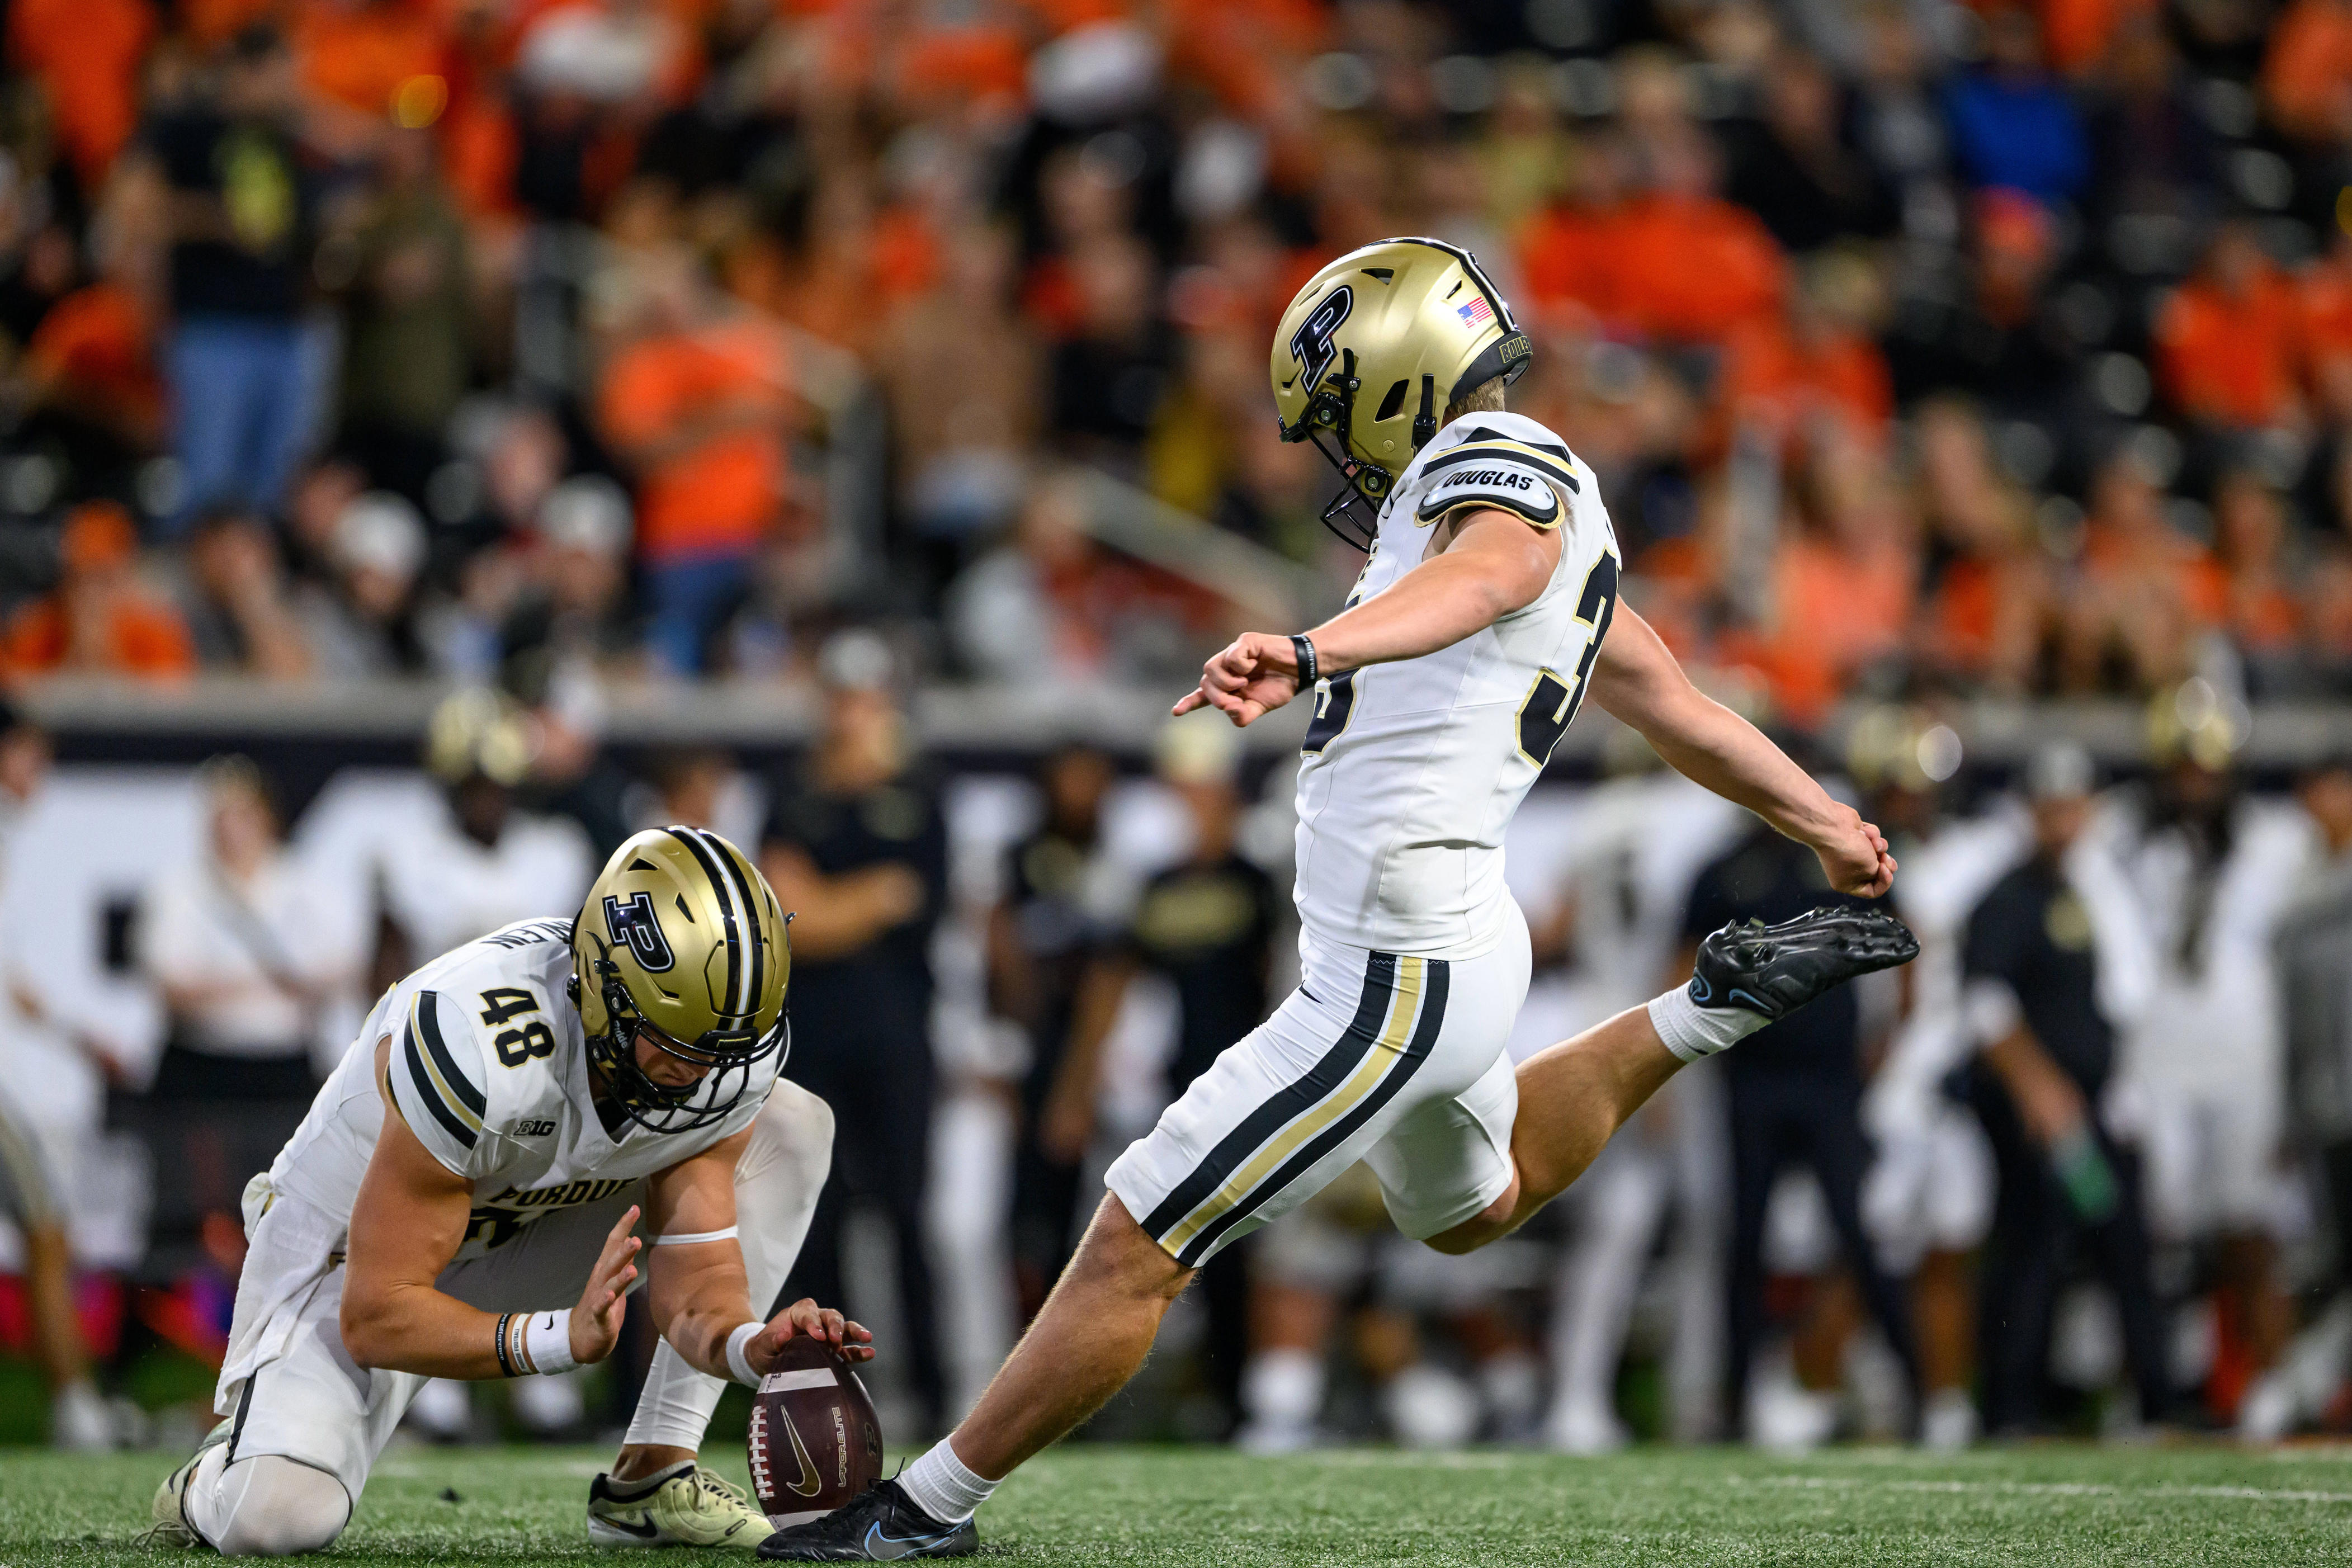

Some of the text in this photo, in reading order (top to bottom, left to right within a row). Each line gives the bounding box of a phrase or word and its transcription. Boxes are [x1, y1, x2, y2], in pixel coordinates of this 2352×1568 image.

[1290, 284, 1354, 401] P
[1442, 470, 1533, 490] DOUGLAS
[1515, 543, 1622, 772] 3
[602, 891, 676, 974] P
[477, 986, 555, 1070] 48
[615, 1019, 628, 1049] Ridde
